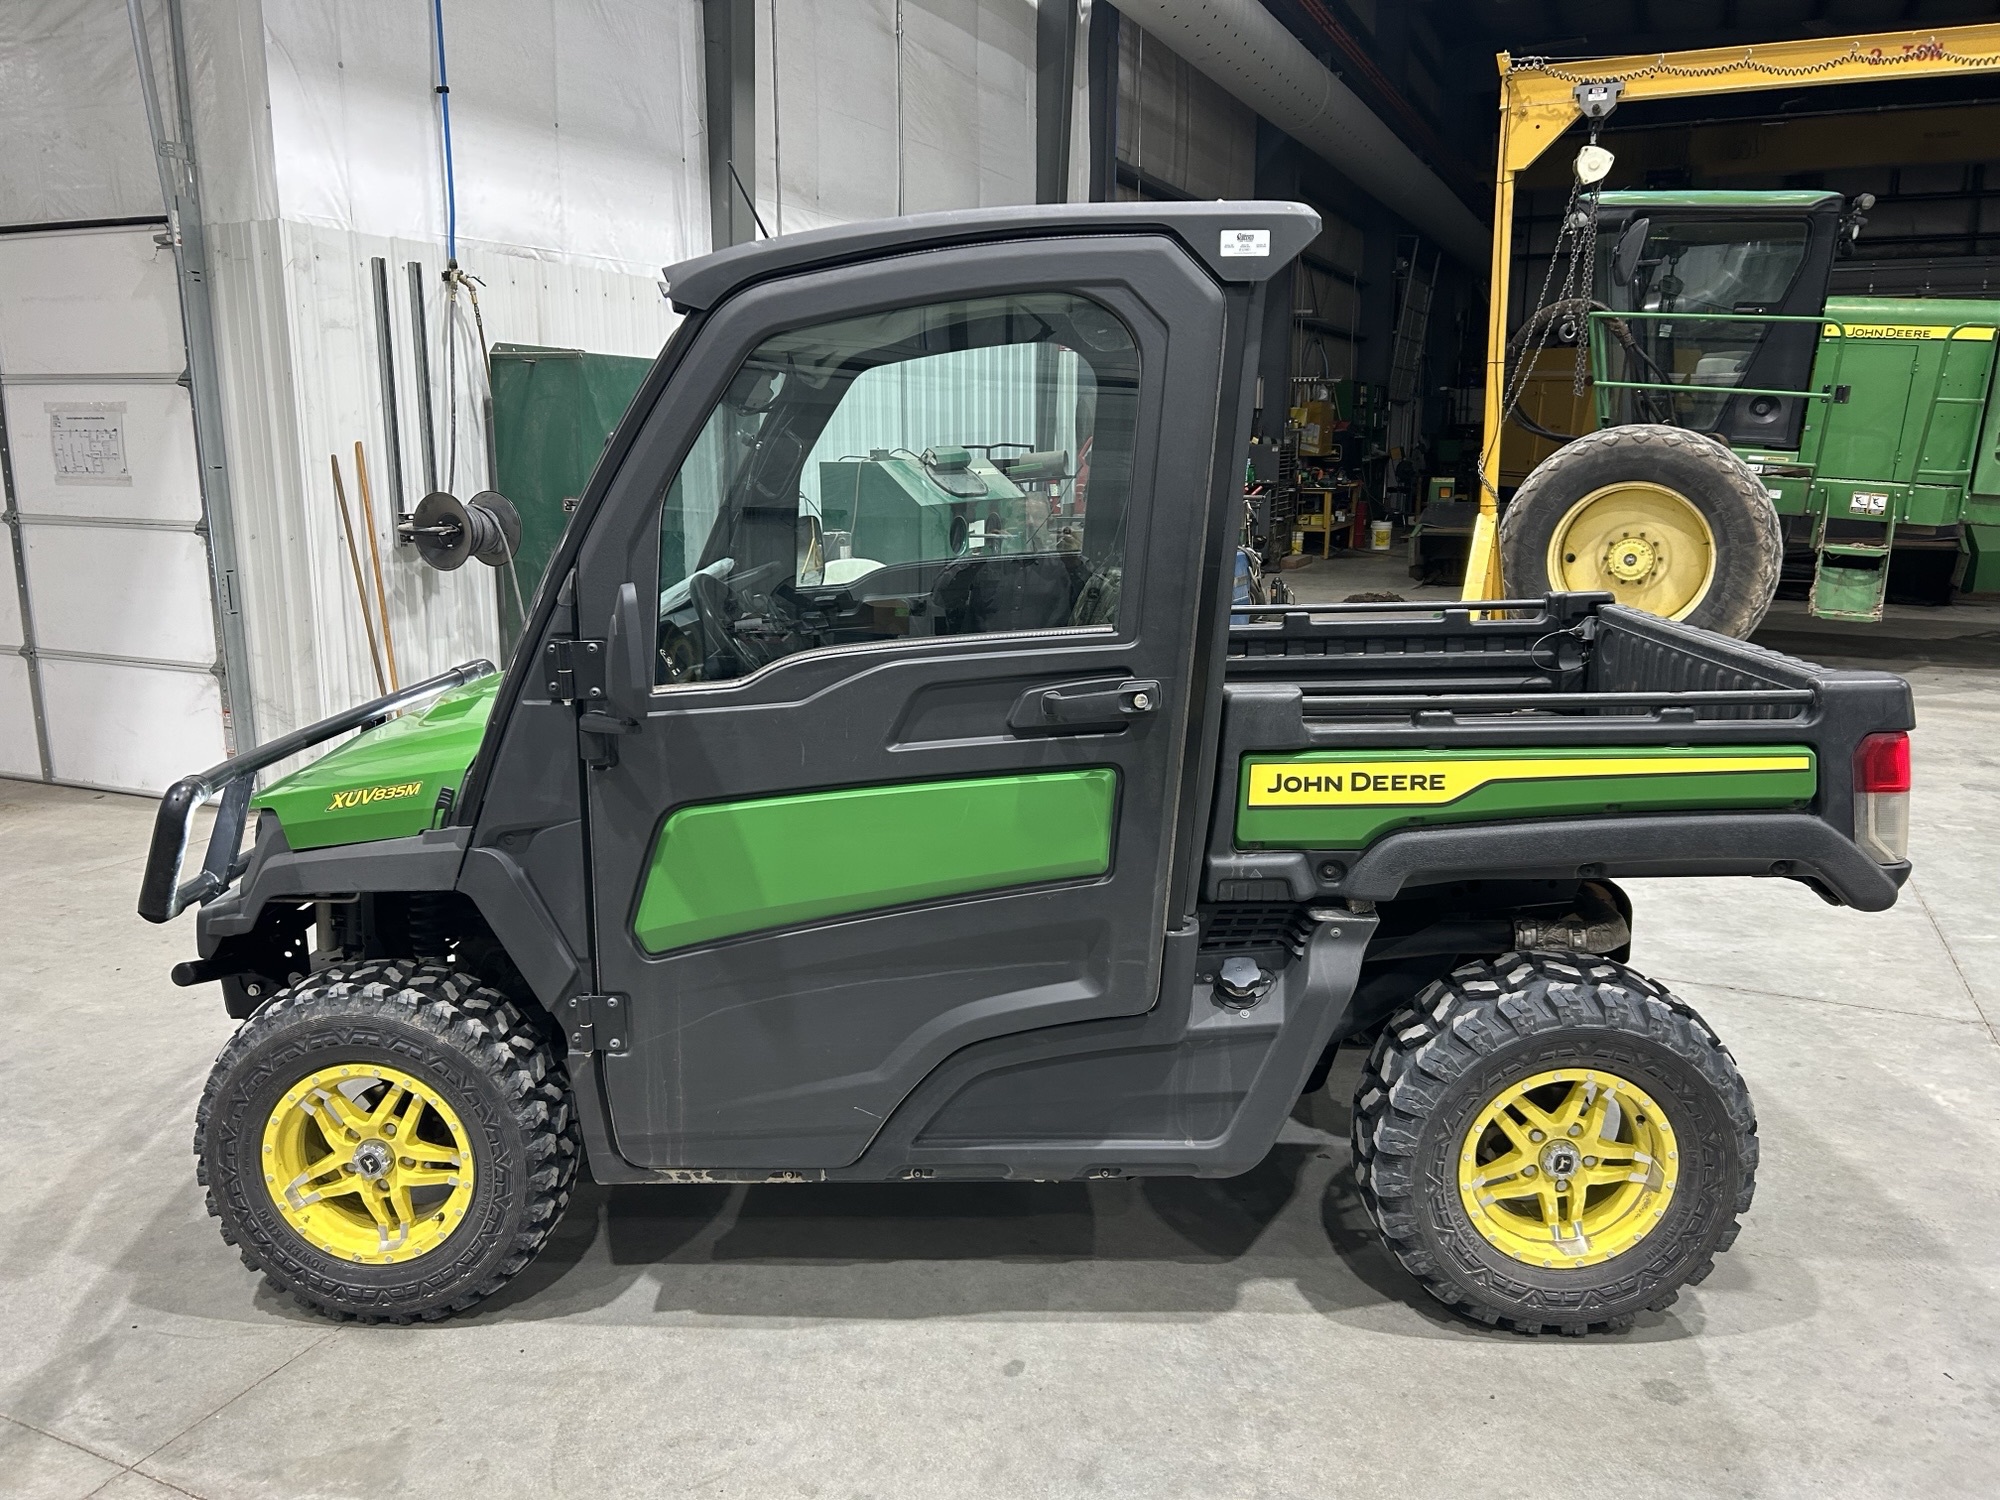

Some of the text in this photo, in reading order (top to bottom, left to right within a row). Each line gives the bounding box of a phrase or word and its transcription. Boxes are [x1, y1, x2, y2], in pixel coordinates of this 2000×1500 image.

[1869, 43, 1944, 65] 2 TON
[1847, 326, 1931, 338] JOHN DEERE
[1267, 772, 1446, 794] JOHN DEERE
[327, 783, 422, 811] XUV835M
[259, 1208, 329, 1273] POWER KING
